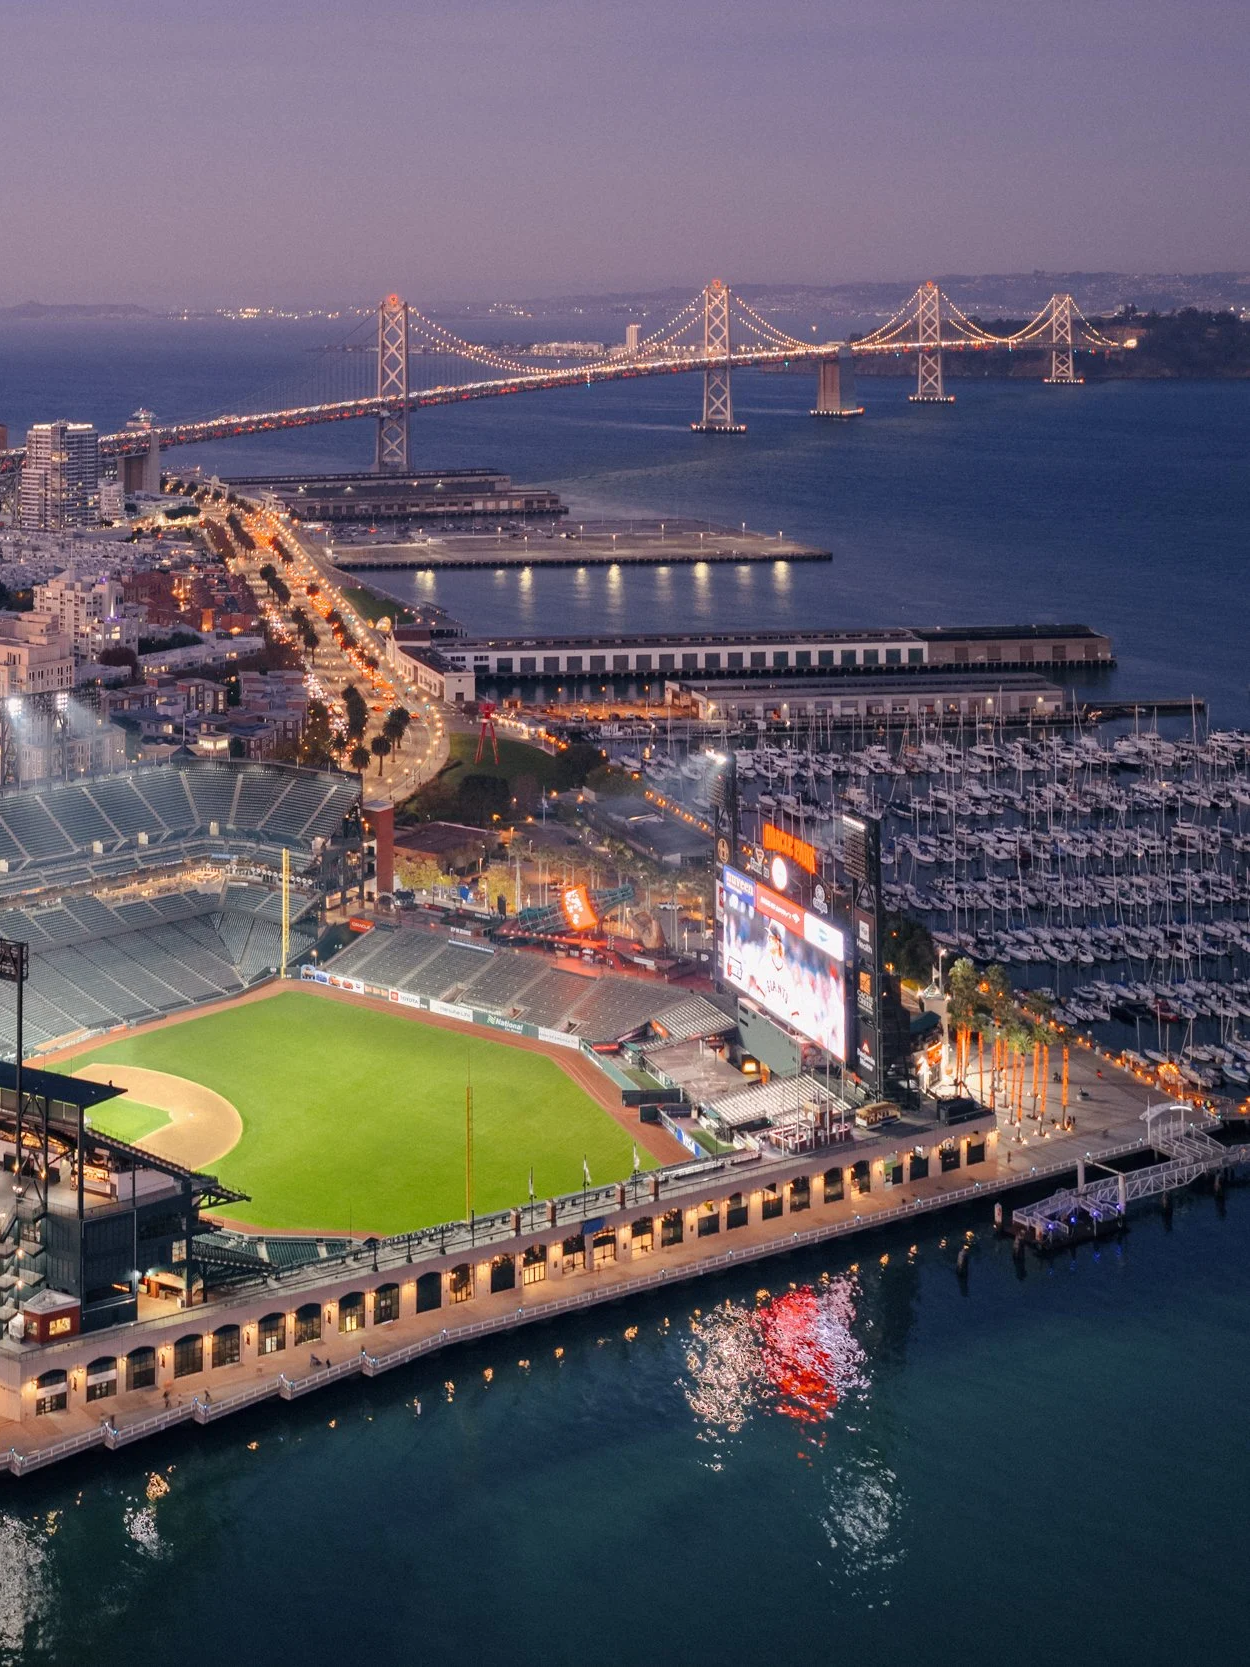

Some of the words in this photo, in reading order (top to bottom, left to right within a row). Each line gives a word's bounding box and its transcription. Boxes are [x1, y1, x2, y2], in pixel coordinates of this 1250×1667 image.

[725, 871, 754, 897] nuveen
[351, 921, 371, 930] ORACLE
[856, 938, 873, 954] Health
[400, 995, 419, 1004] TOYOTA
[496, 1017, 524, 1031] National
